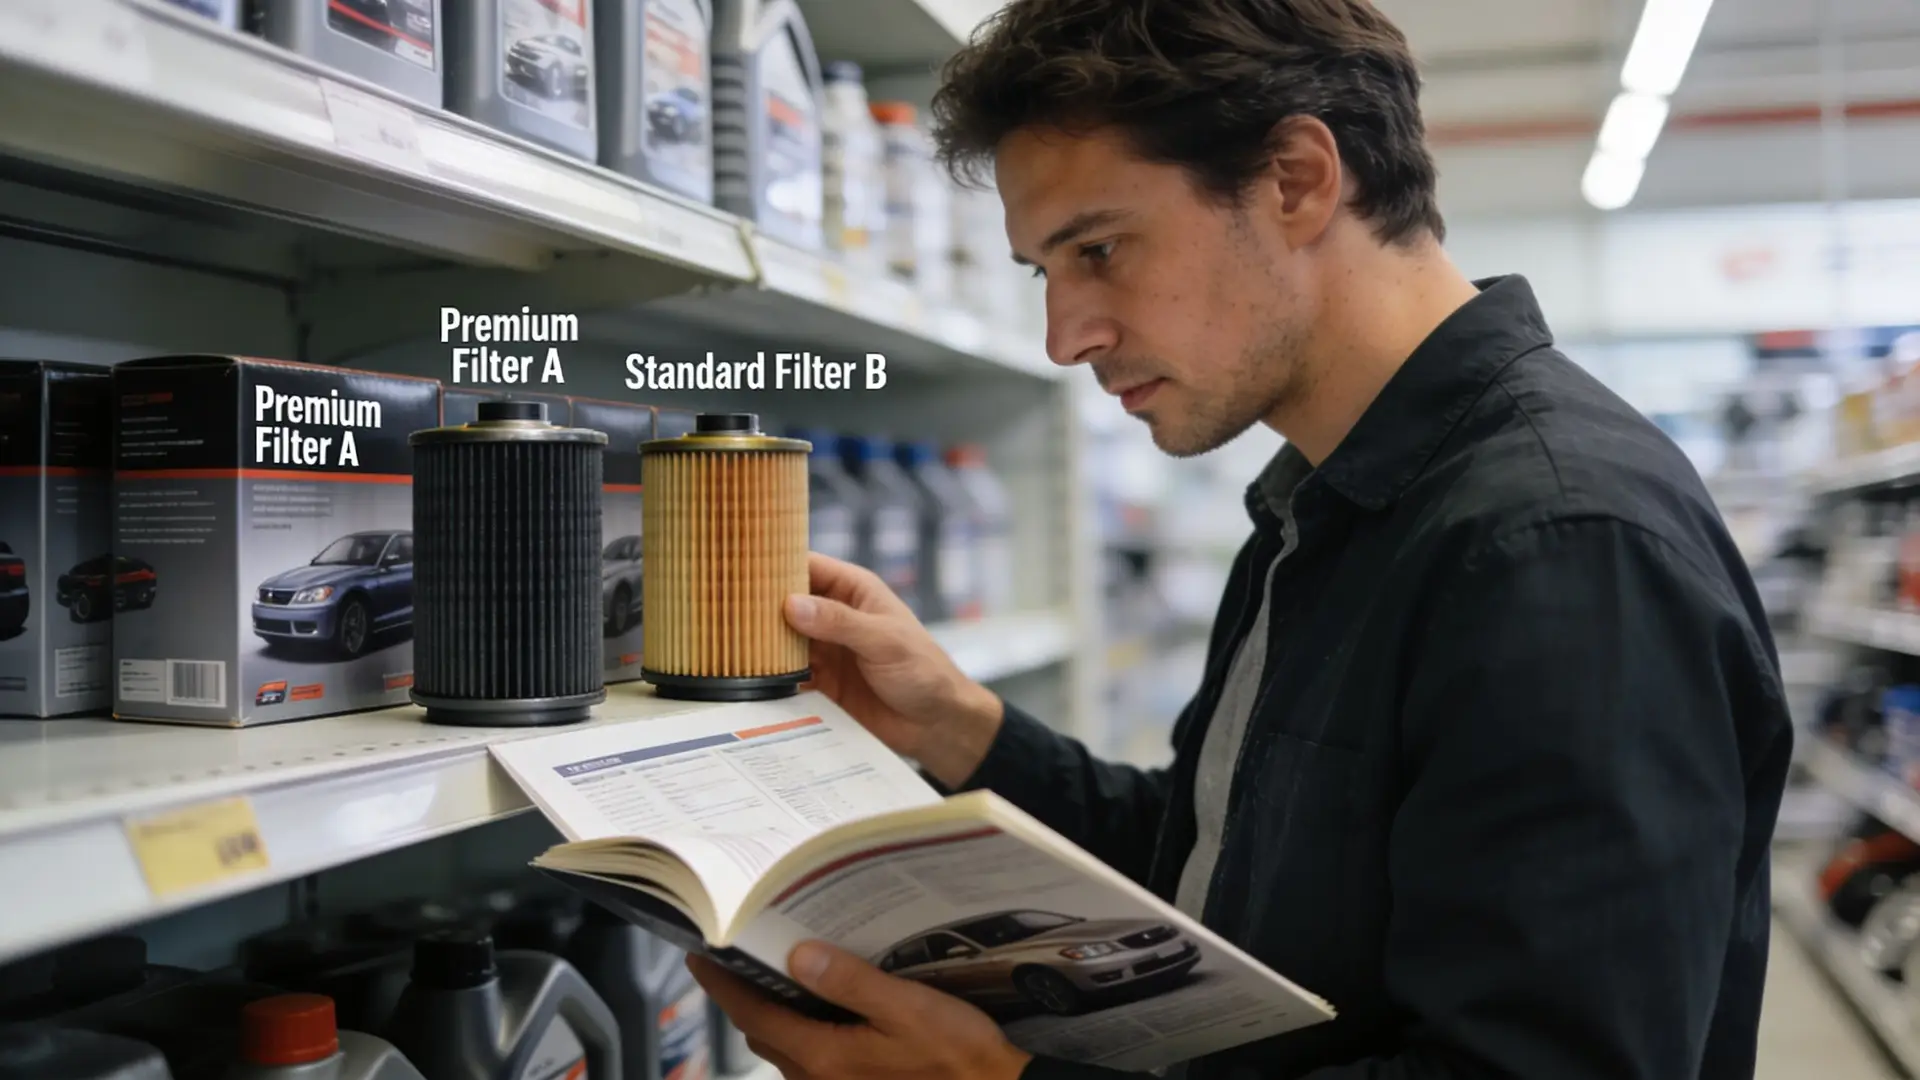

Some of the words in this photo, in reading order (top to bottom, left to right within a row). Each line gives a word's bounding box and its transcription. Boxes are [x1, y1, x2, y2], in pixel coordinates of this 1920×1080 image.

[255, 384, 381, 428] Premium
[255, 426, 332, 466] Filter
[338, 430, 359, 467] A
